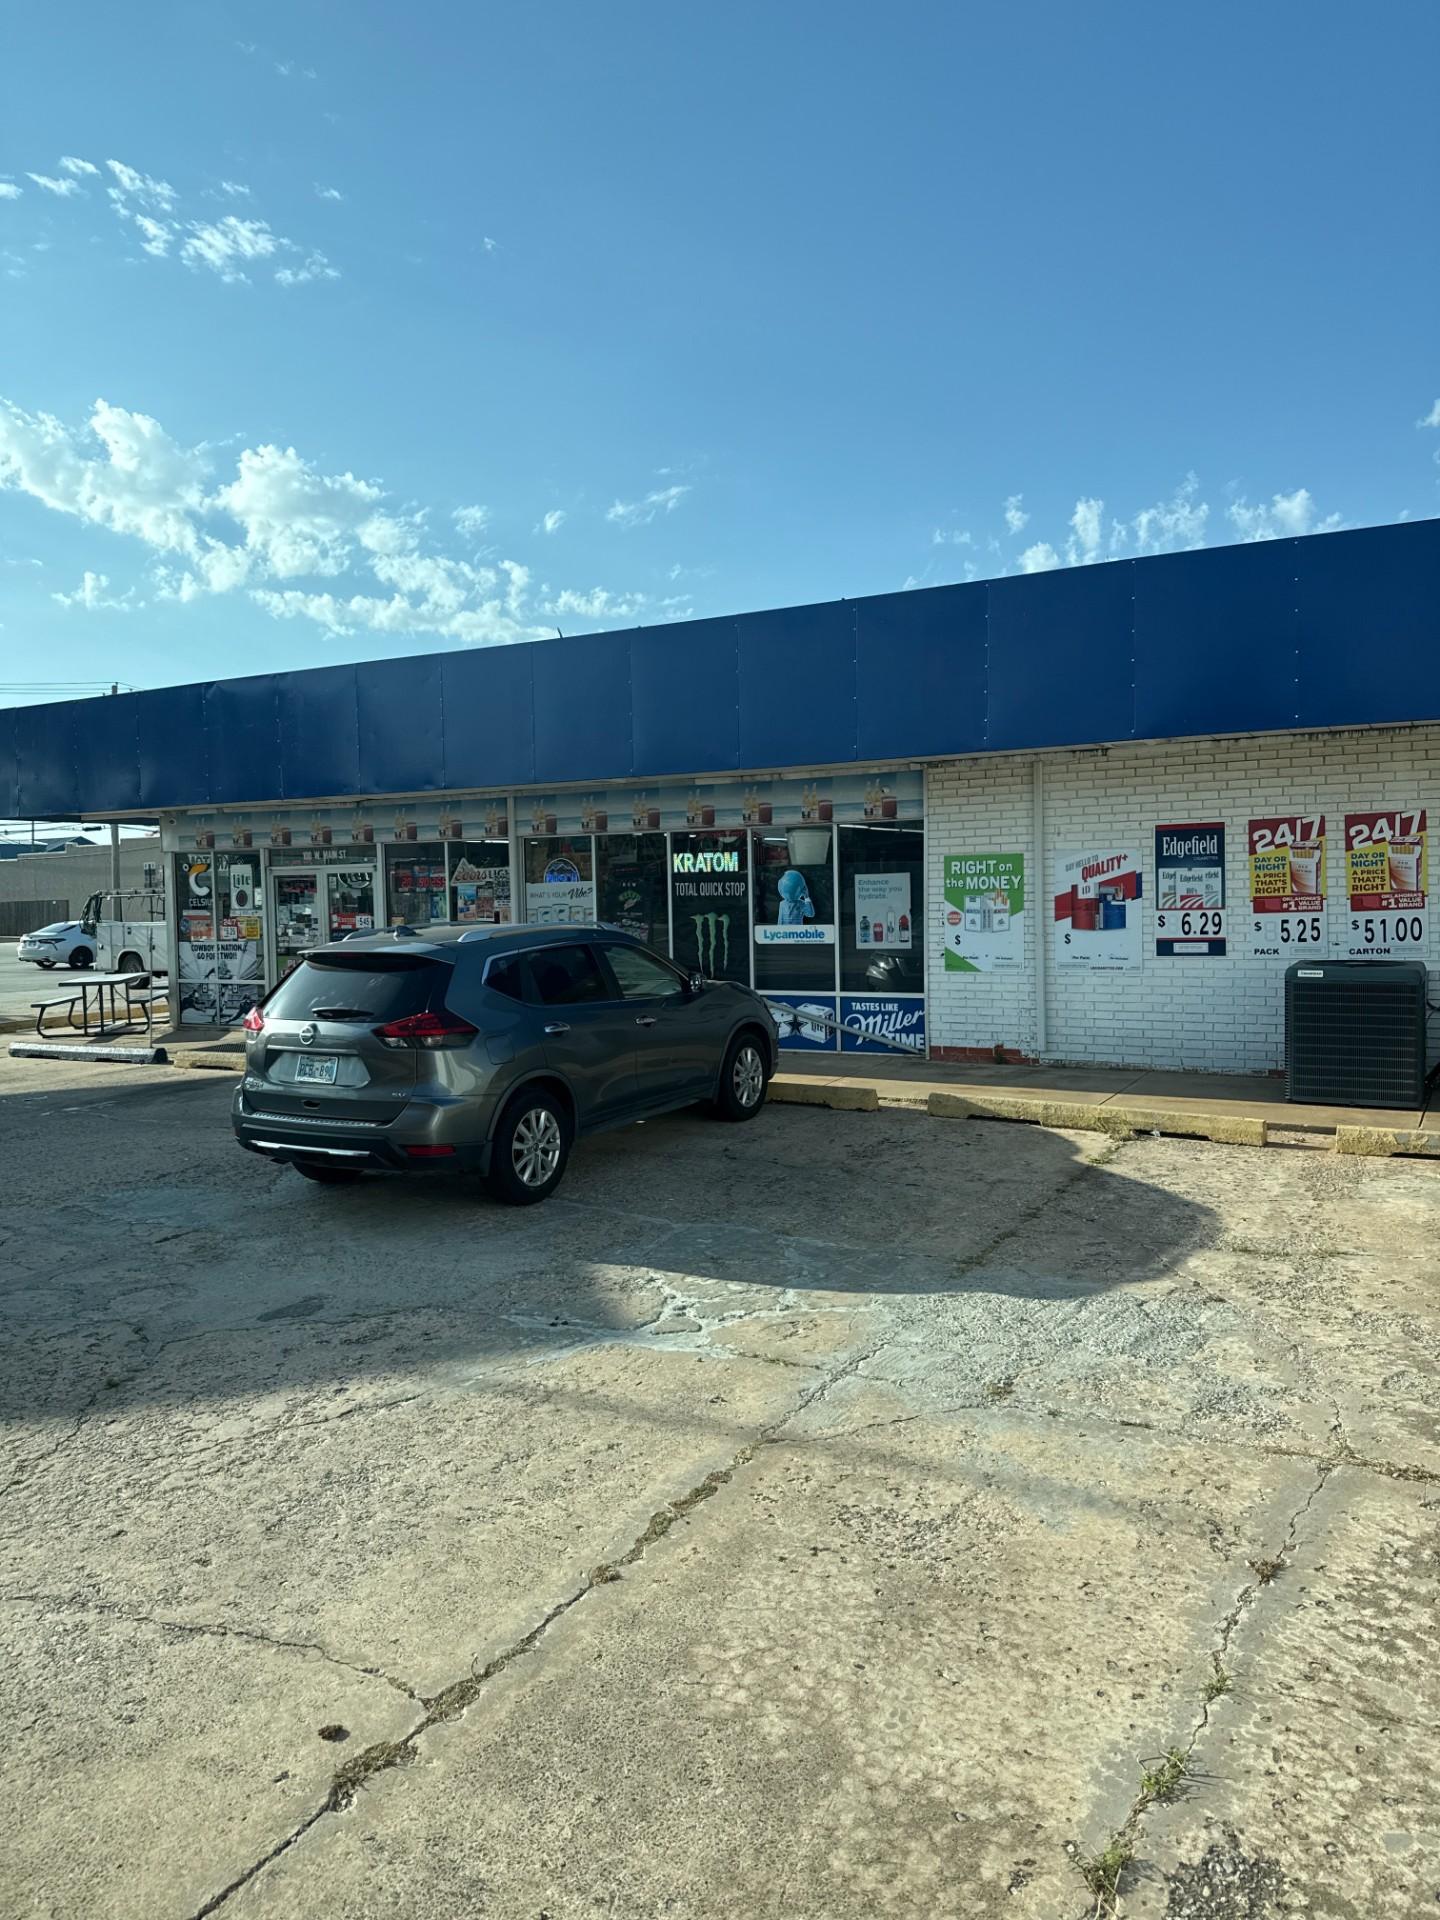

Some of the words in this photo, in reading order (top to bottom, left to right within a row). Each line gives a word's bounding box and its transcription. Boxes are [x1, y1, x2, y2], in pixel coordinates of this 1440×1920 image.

[1162, 834, 1217, 858] Edgefield
[673, 851, 739, 873] KRATOM
[1075, 858, 1092, 870] HELLO
[1092, 854, 1099, 864] TO
[1351, 852, 1369, 860] DAY
[1371, 851, 1385, 859] OR
[951, 860, 997, 875] RIGHT
[999, 863, 1013, 872] on
[1254, 863, 1287, 871] NIGHT
[1351, 859, 1385, 868] NIGHT
[232, 873, 251, 889] Lite
[946, 878, 965, 888] the
[966, 875, 1022, 890] MONEY
[1352, 875, 1386, 883] THAT'S
[675, 882, 698, 897] TOTAL
[700, 881, 724, 896] QUICK
[725, 881, 746, 896] STOP
[1255, 886, 1287, 895] RIGHT
[1352, 883, 1386, 892] RIGHT
[189, 898, 215, 906] CELSIU
[1157, 913, 1166, 928] $
[1181, 912, 1222, 936] 6.29
[1254, 921, 1262, 931] $
[1280, 918, 1321, 944] 5.25
[1351, 919, 1360, 930] $
[1364, 917, 1423, 944] 51.00
[764, 928, 826, 942] Lycamobile
[954, 934, 961, 945] $
[1064, 933, 1071, 944] $
[197, 951, 206, 960] GO
[1349, 947, 1391, 955] CARTON
[851, 1002, 880, 1012] TASTES
[881, 1003, 899, 1012] LIKE
[845, 1010, 926, 1045] Miller
[887, 1033, 926, 1050] TIME
